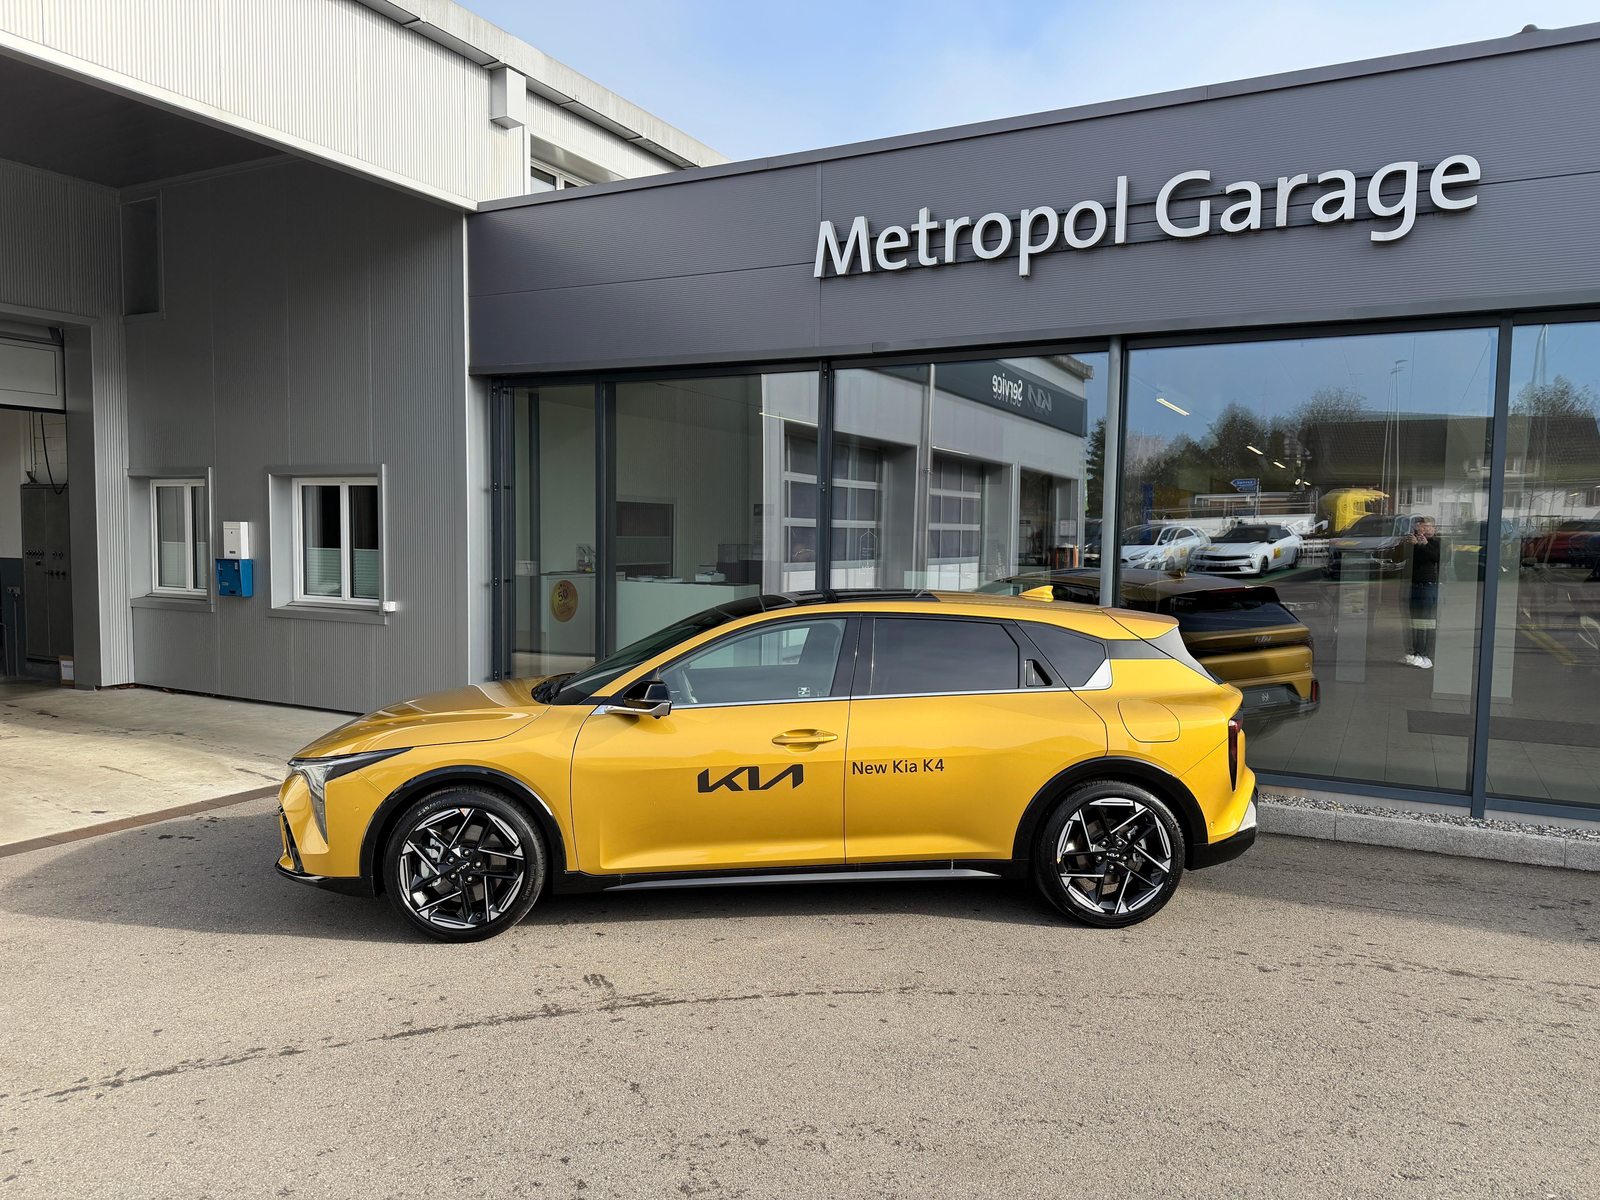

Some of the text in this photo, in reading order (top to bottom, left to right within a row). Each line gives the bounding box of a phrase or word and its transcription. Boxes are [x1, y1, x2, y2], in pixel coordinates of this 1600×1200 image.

[814, 154, 1481, 277] Metropol Garage
[697, 764, 804, 793] KIA
[852, 758, 945, 775] New Kia K4
